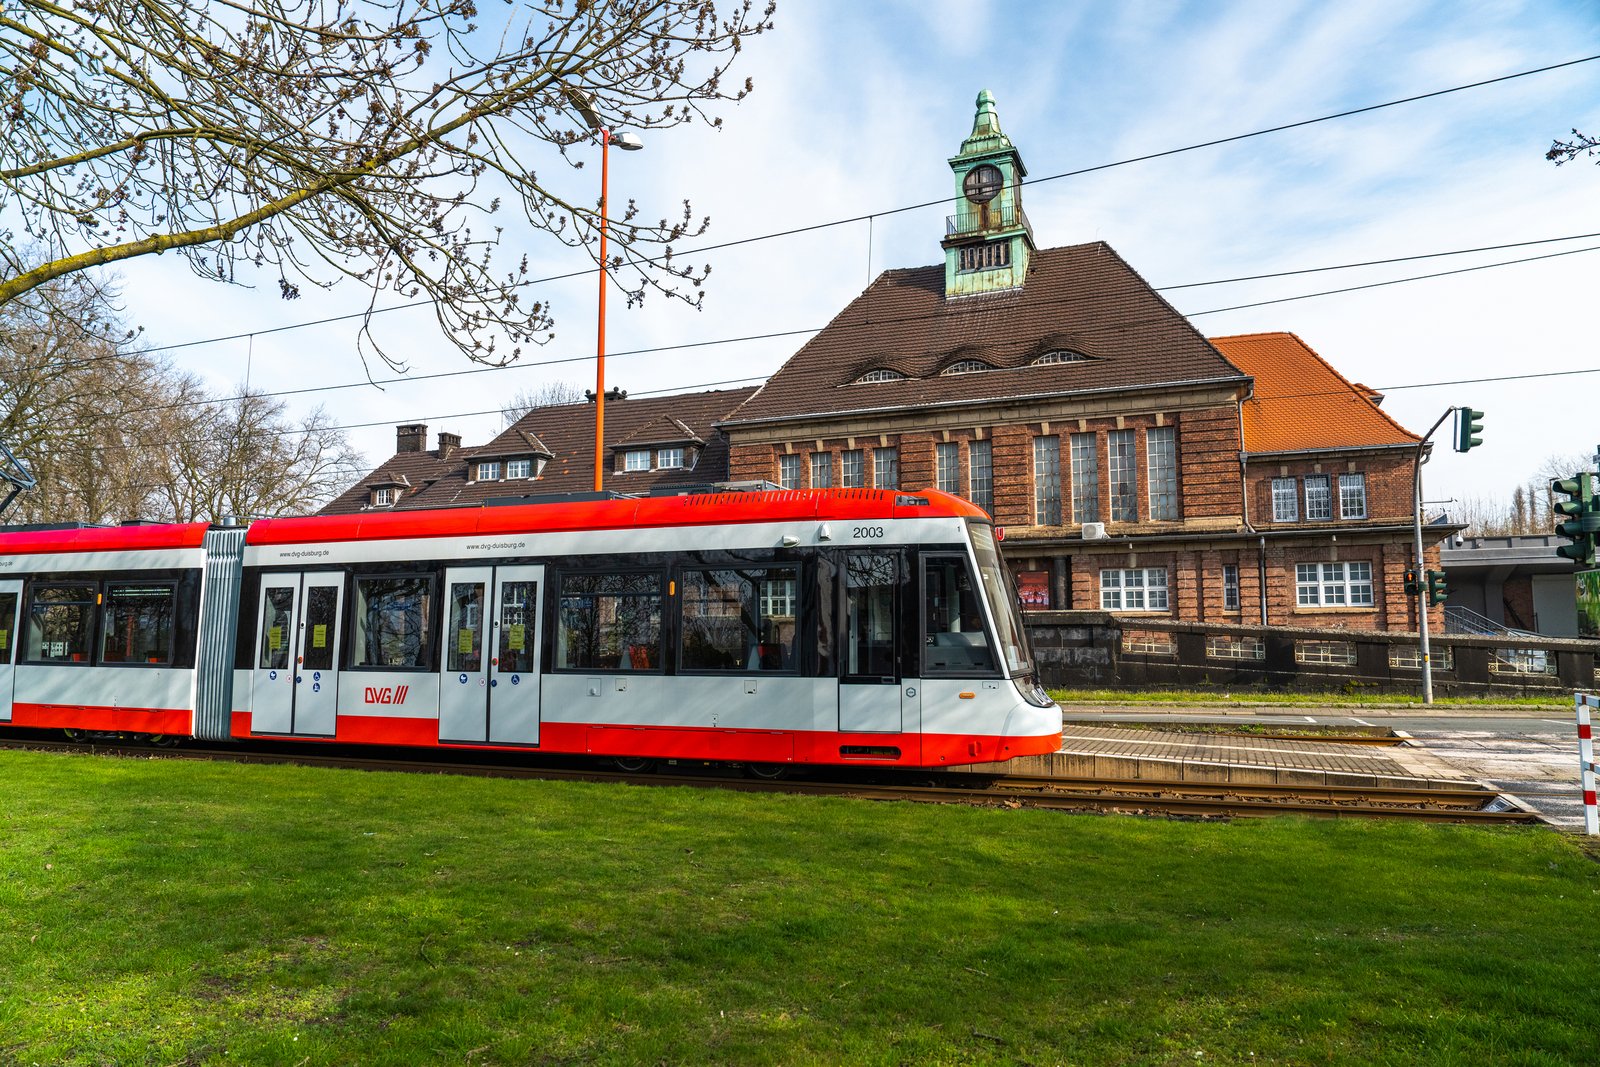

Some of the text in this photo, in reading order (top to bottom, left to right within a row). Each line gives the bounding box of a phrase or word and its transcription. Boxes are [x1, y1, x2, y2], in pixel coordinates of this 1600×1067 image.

[853, 526, 884, 539] 2003
[995, 527, 1006, 541] U
[466, 542, 526, 551] www.dvg-duisburg.de
[279, 550, 330, 558] www.dvg-duisburg.de
